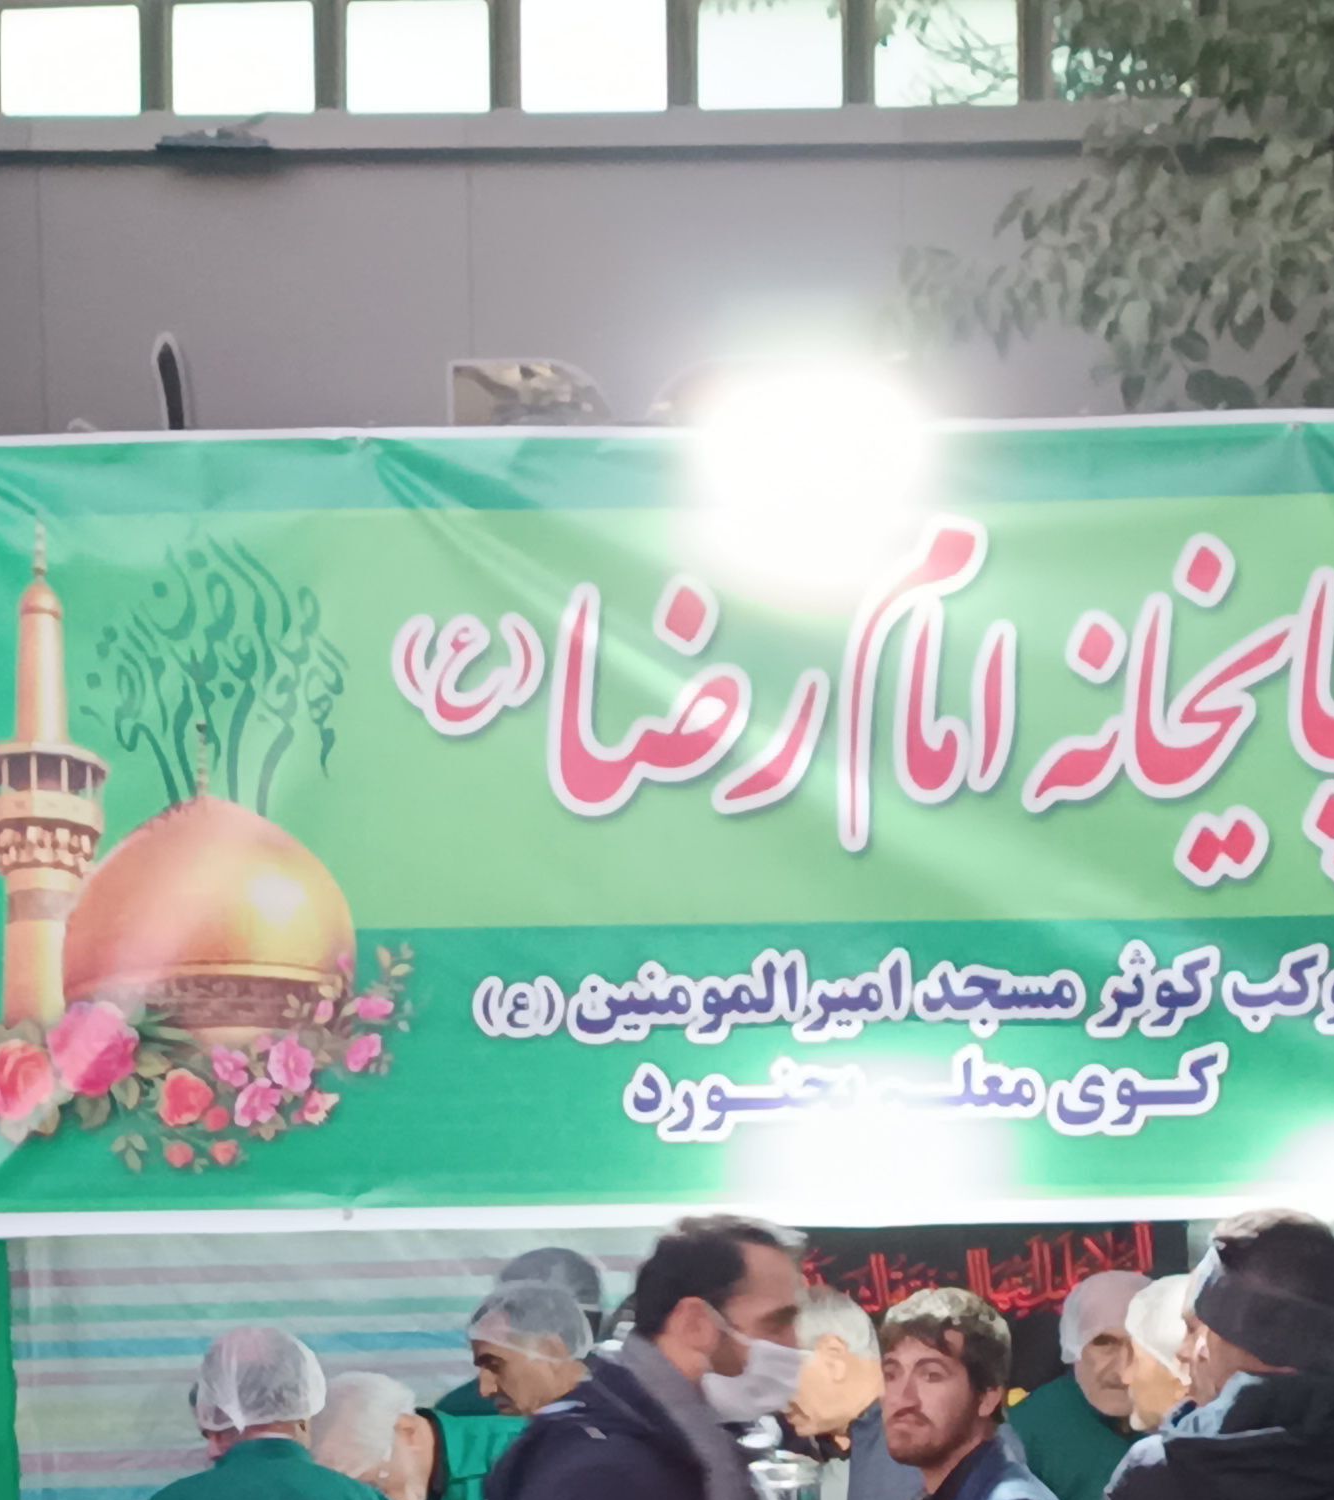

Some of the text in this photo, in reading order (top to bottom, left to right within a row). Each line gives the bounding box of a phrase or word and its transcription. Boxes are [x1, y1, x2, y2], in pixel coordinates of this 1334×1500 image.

[548, 572, 831, 817] رضا
[839, 513, 1019, 853] امام
[914, 960, 1085, 1038] مسجد
[1085, 940, 1221, 1038] کوثر
[1047, 1041, 1229, 1136] کوی
